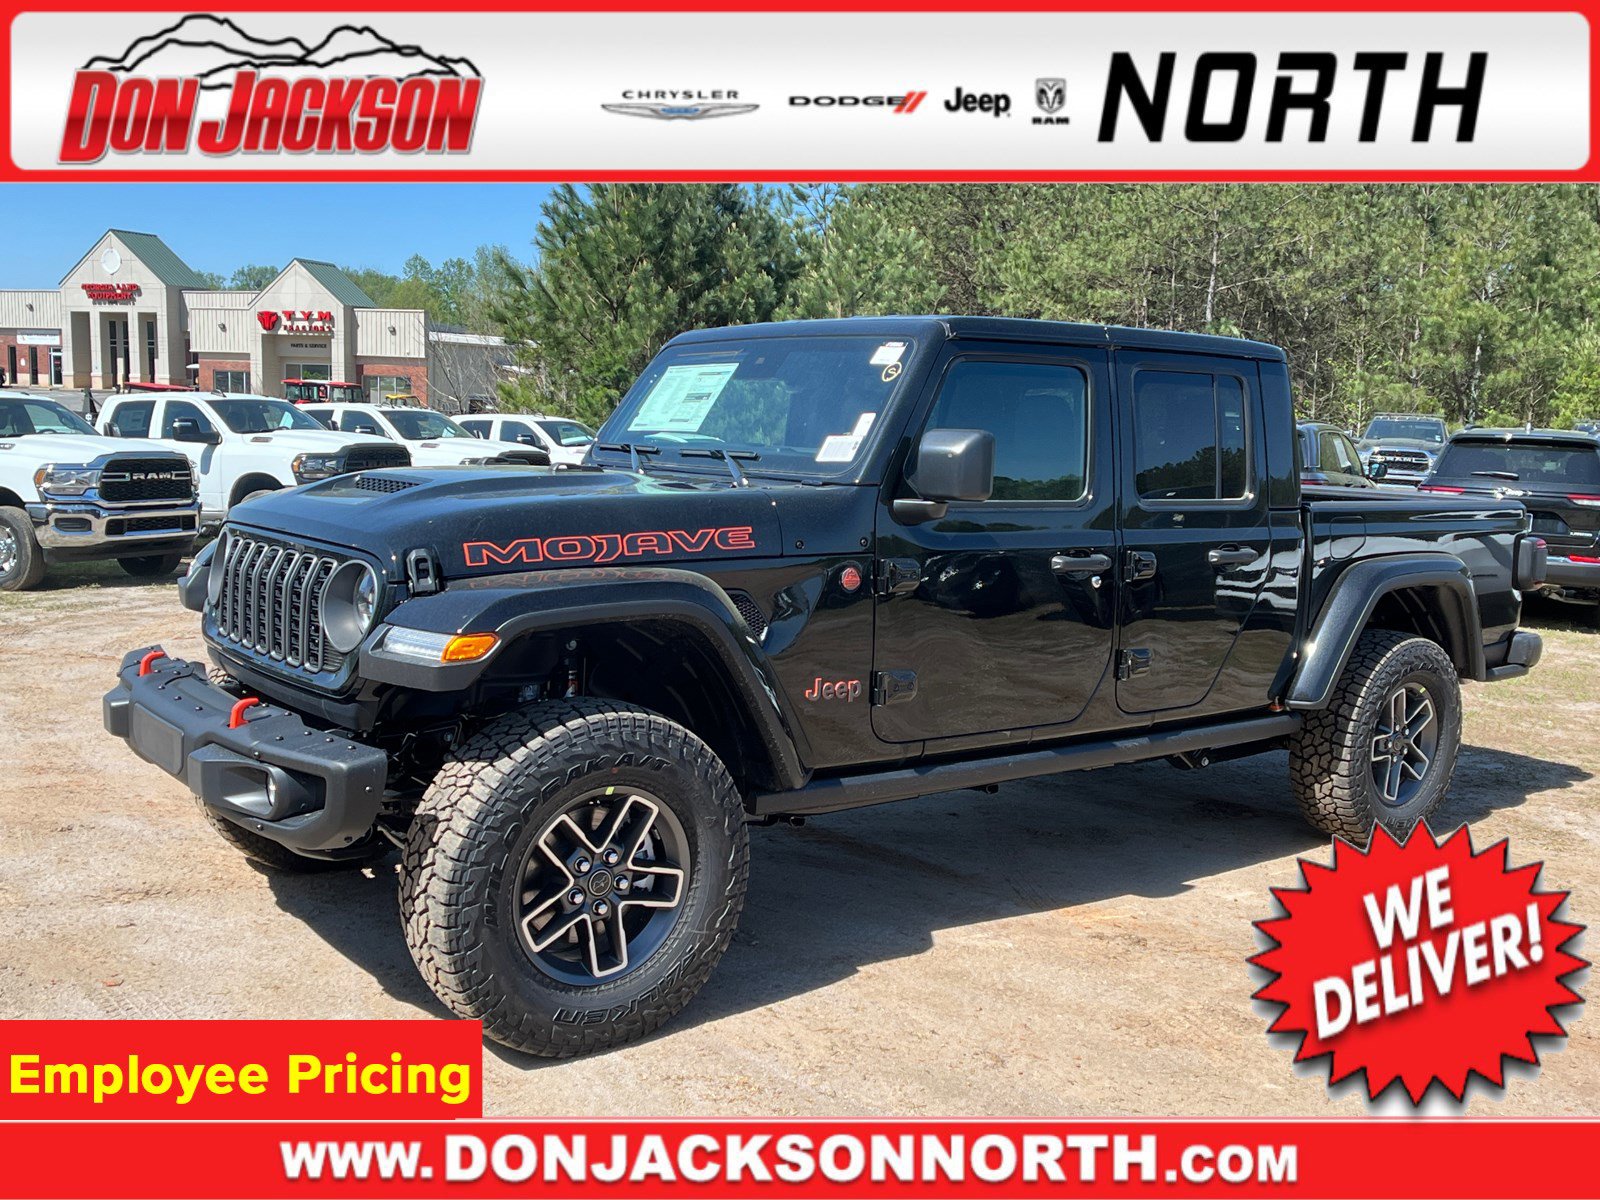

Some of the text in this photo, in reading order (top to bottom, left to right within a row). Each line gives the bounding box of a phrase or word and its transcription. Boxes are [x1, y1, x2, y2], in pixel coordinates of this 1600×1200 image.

[132, 472, 171, 480] RAM
[463, 526, 755, 566] MOJAVE
[805, 677, 862, 702] Jeep
